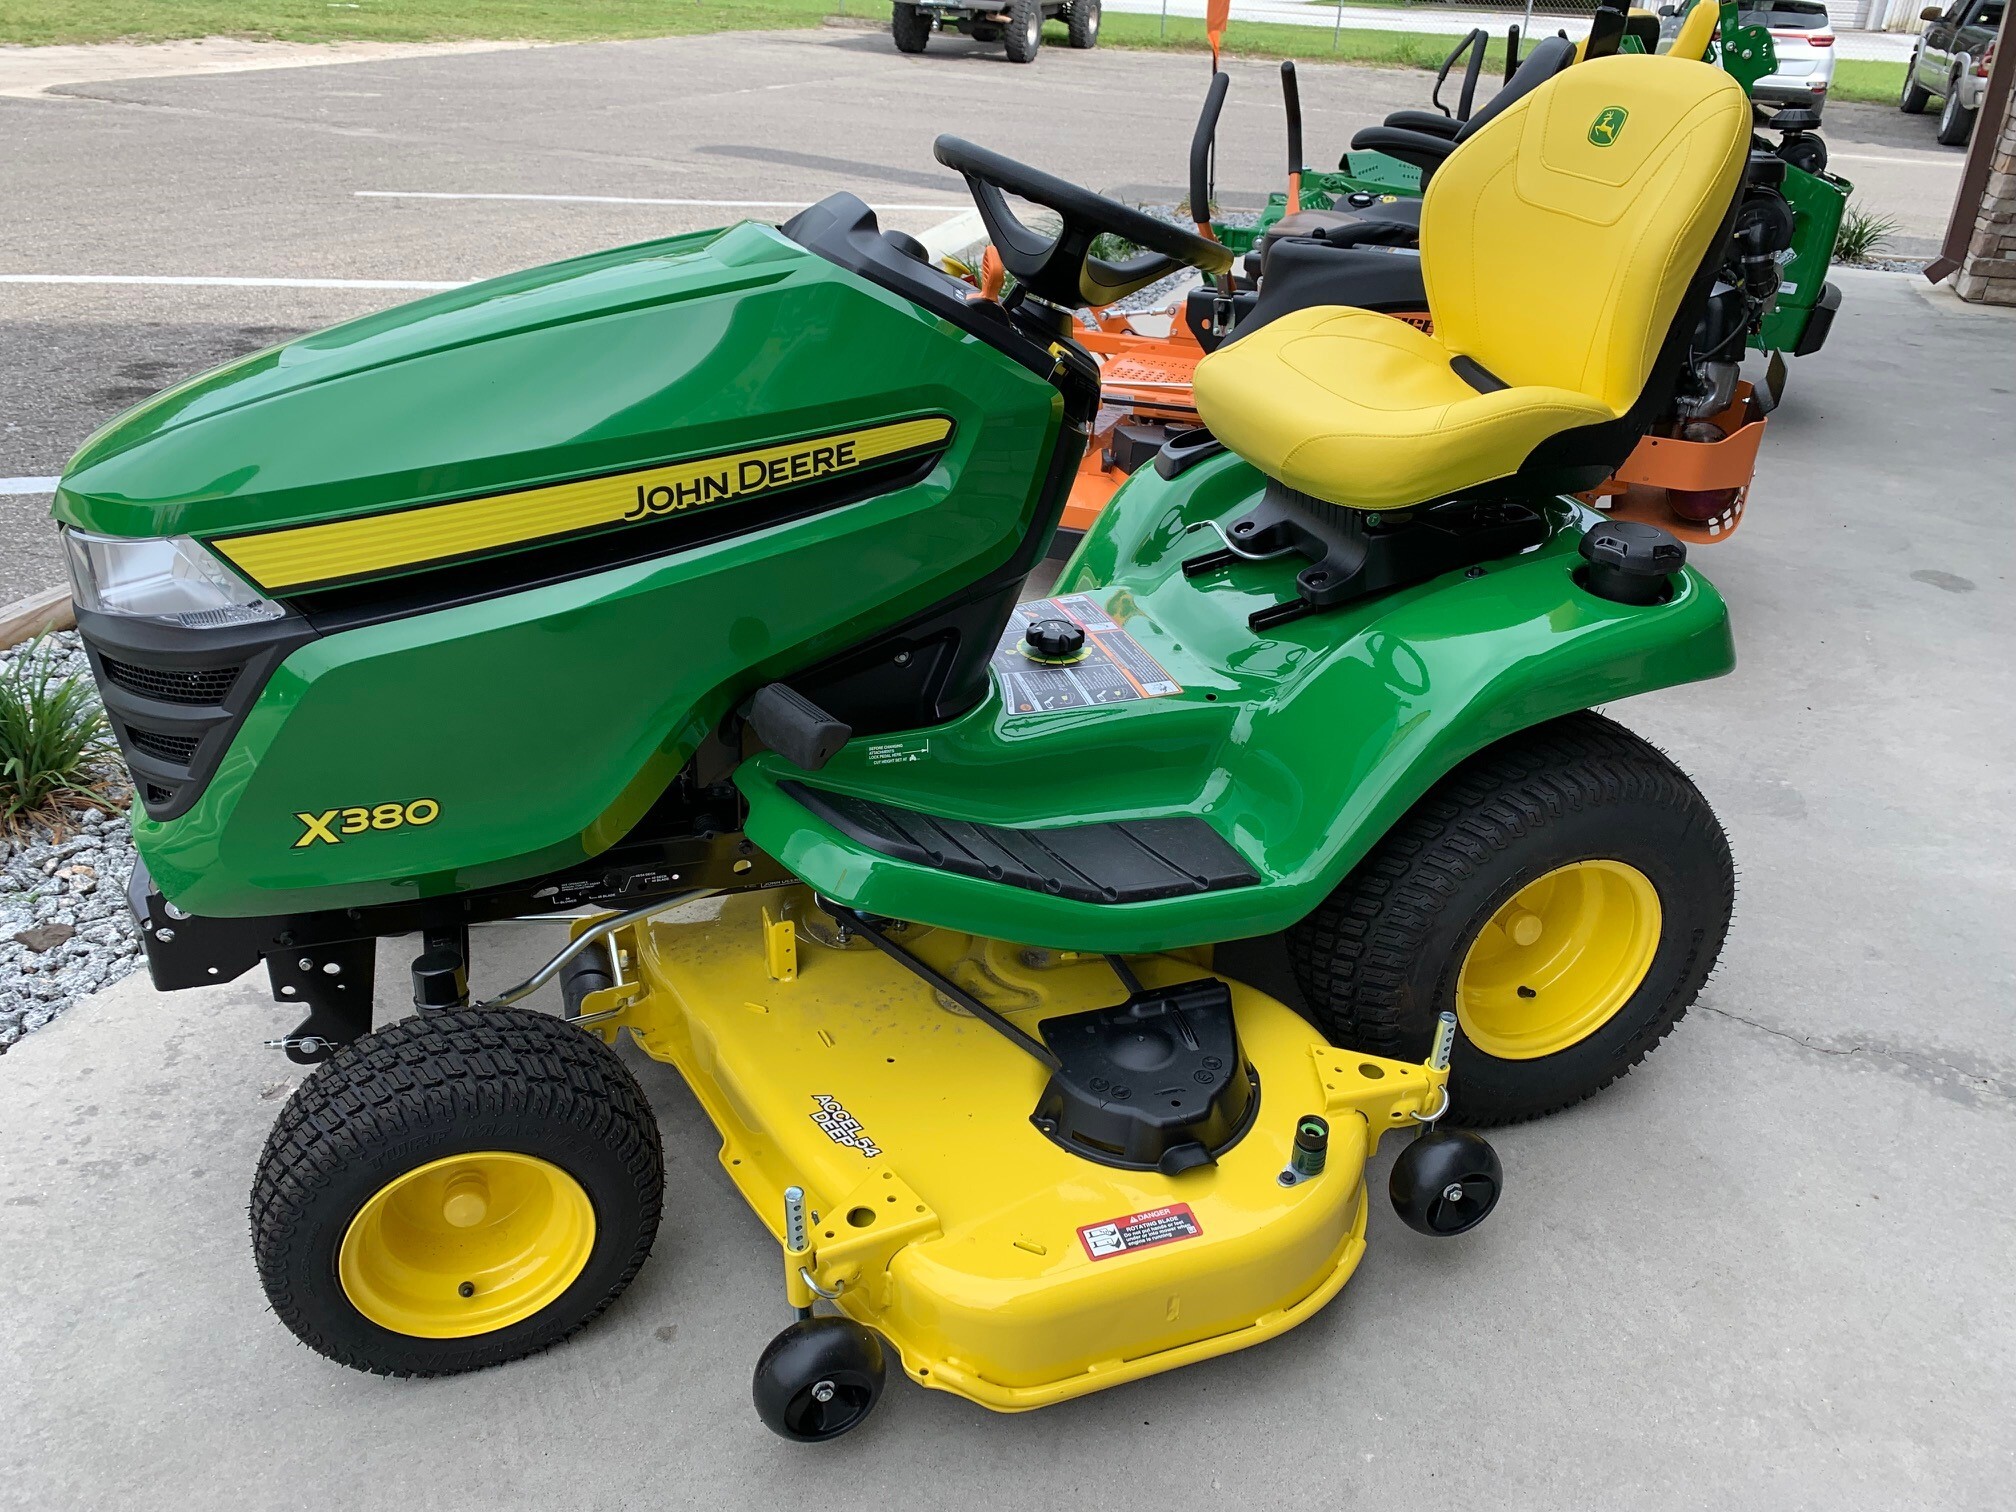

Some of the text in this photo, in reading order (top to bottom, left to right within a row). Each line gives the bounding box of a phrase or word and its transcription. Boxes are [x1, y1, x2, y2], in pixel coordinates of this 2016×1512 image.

[624, 440, 857, 519] JOHN DEERE
[291, 798, 441, 849] X380
[811, 1094, 865, 1139] ACCEL
[809, 1110, 883, 1158] DEEP 54
[1138, 1209, 1171, 1221] DANGER
[1126, 1216, 1178, 1232] ROTATING BLADE
[1141, 1227, 1151, 1235] put
[1151, 1223, 1166, 1232] hands
[1159, 1227, 1176, 1235] mower
[1177, 1223, 1191, 1231] when
[1128, 1239, 1146, 1247] engine
[1152, 1232, 1173, 1241] running
